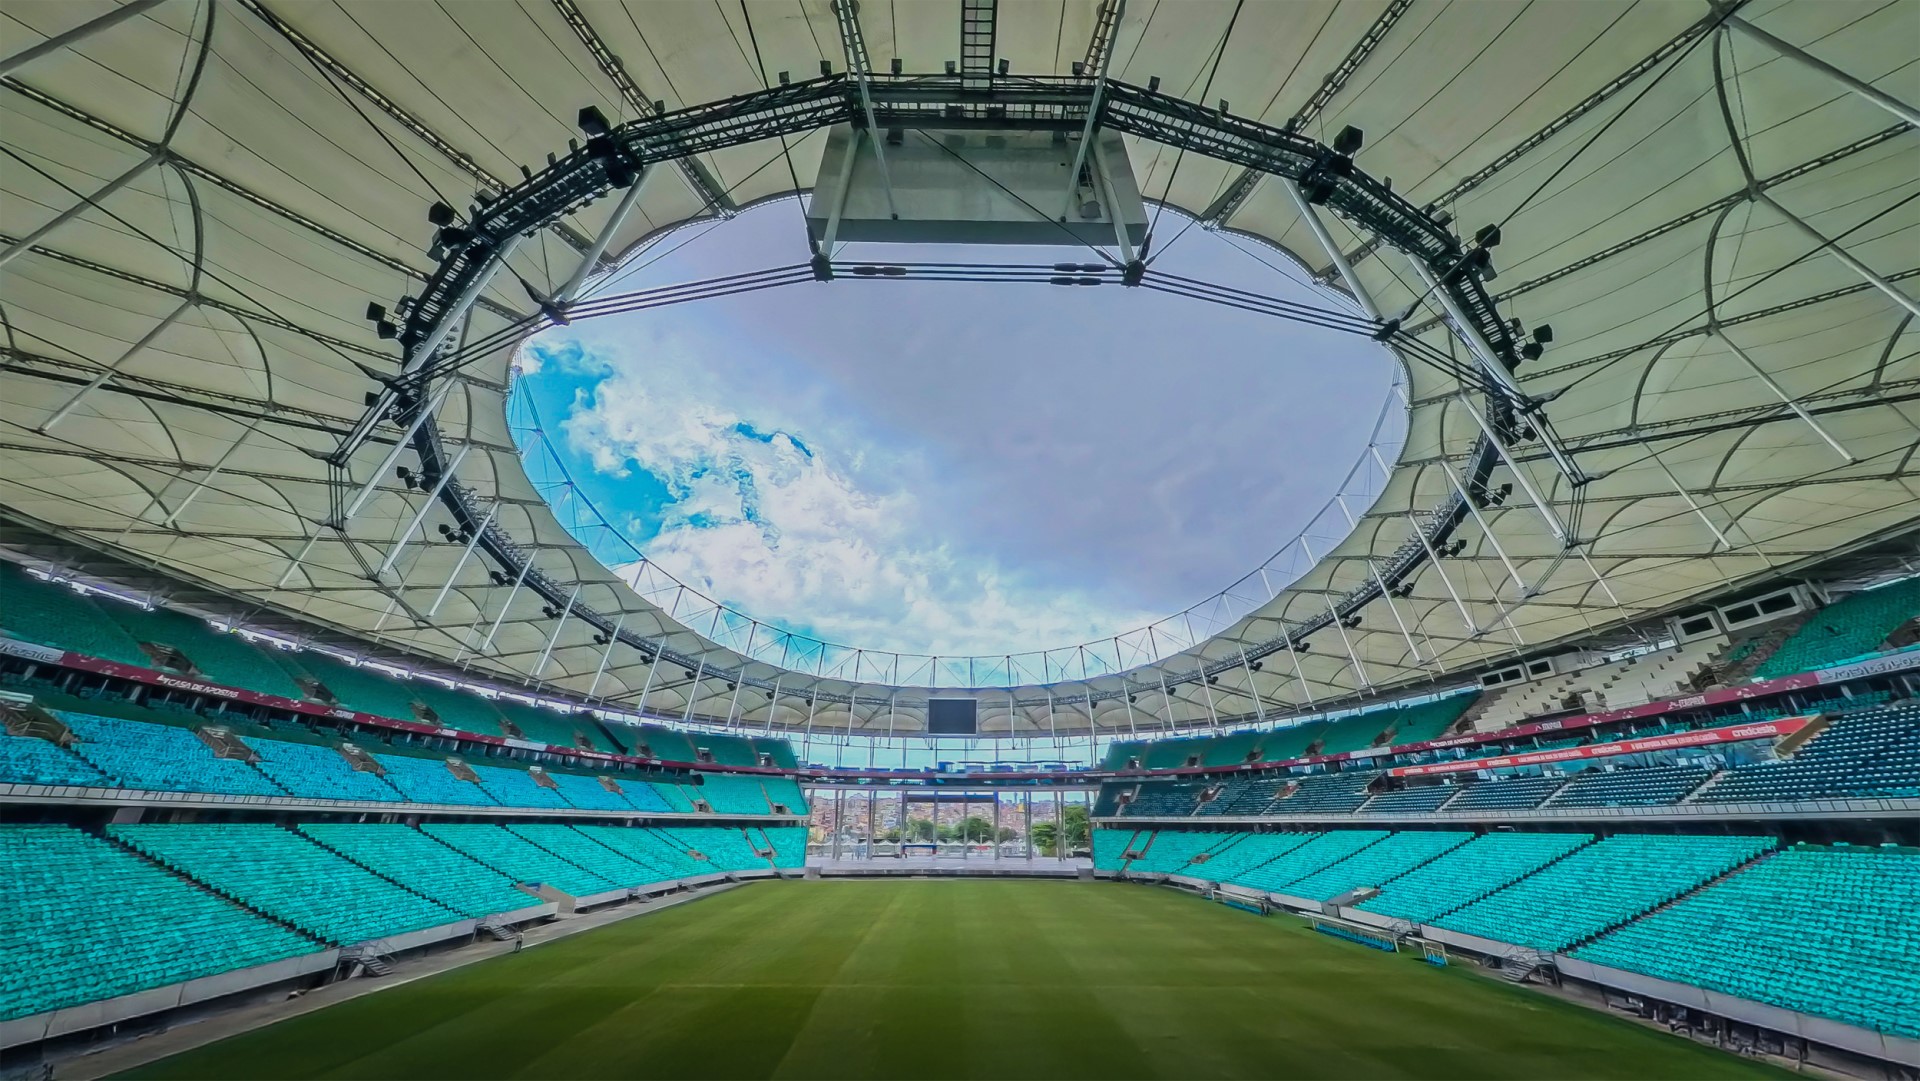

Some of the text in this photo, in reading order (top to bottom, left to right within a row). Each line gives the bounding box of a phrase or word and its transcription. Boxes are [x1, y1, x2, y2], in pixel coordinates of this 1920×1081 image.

[168, 679, 239, 698] CASA DE APOSTAS
